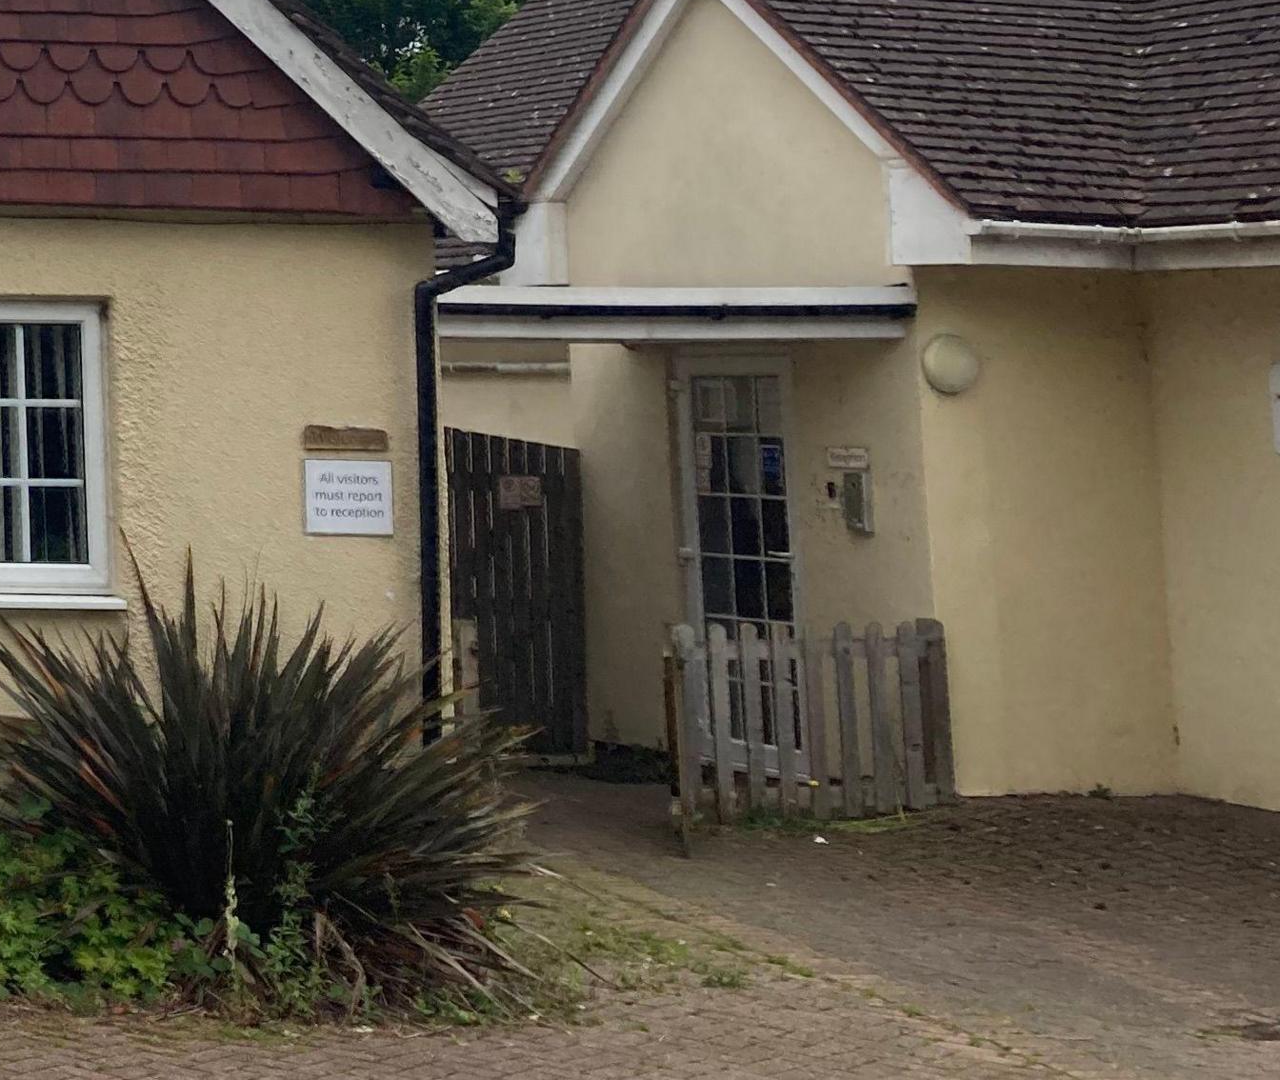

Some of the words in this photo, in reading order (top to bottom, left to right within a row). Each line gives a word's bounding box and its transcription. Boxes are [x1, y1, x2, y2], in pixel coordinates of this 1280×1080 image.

[320, 472, 334, 484] All
[336, 473, 379, 485] visitors
[315, 491, 344, 501] must
[347, 491, 383, 503] report
[315, 507, 328, 517] to
[331, 507, 385, 519] reception
